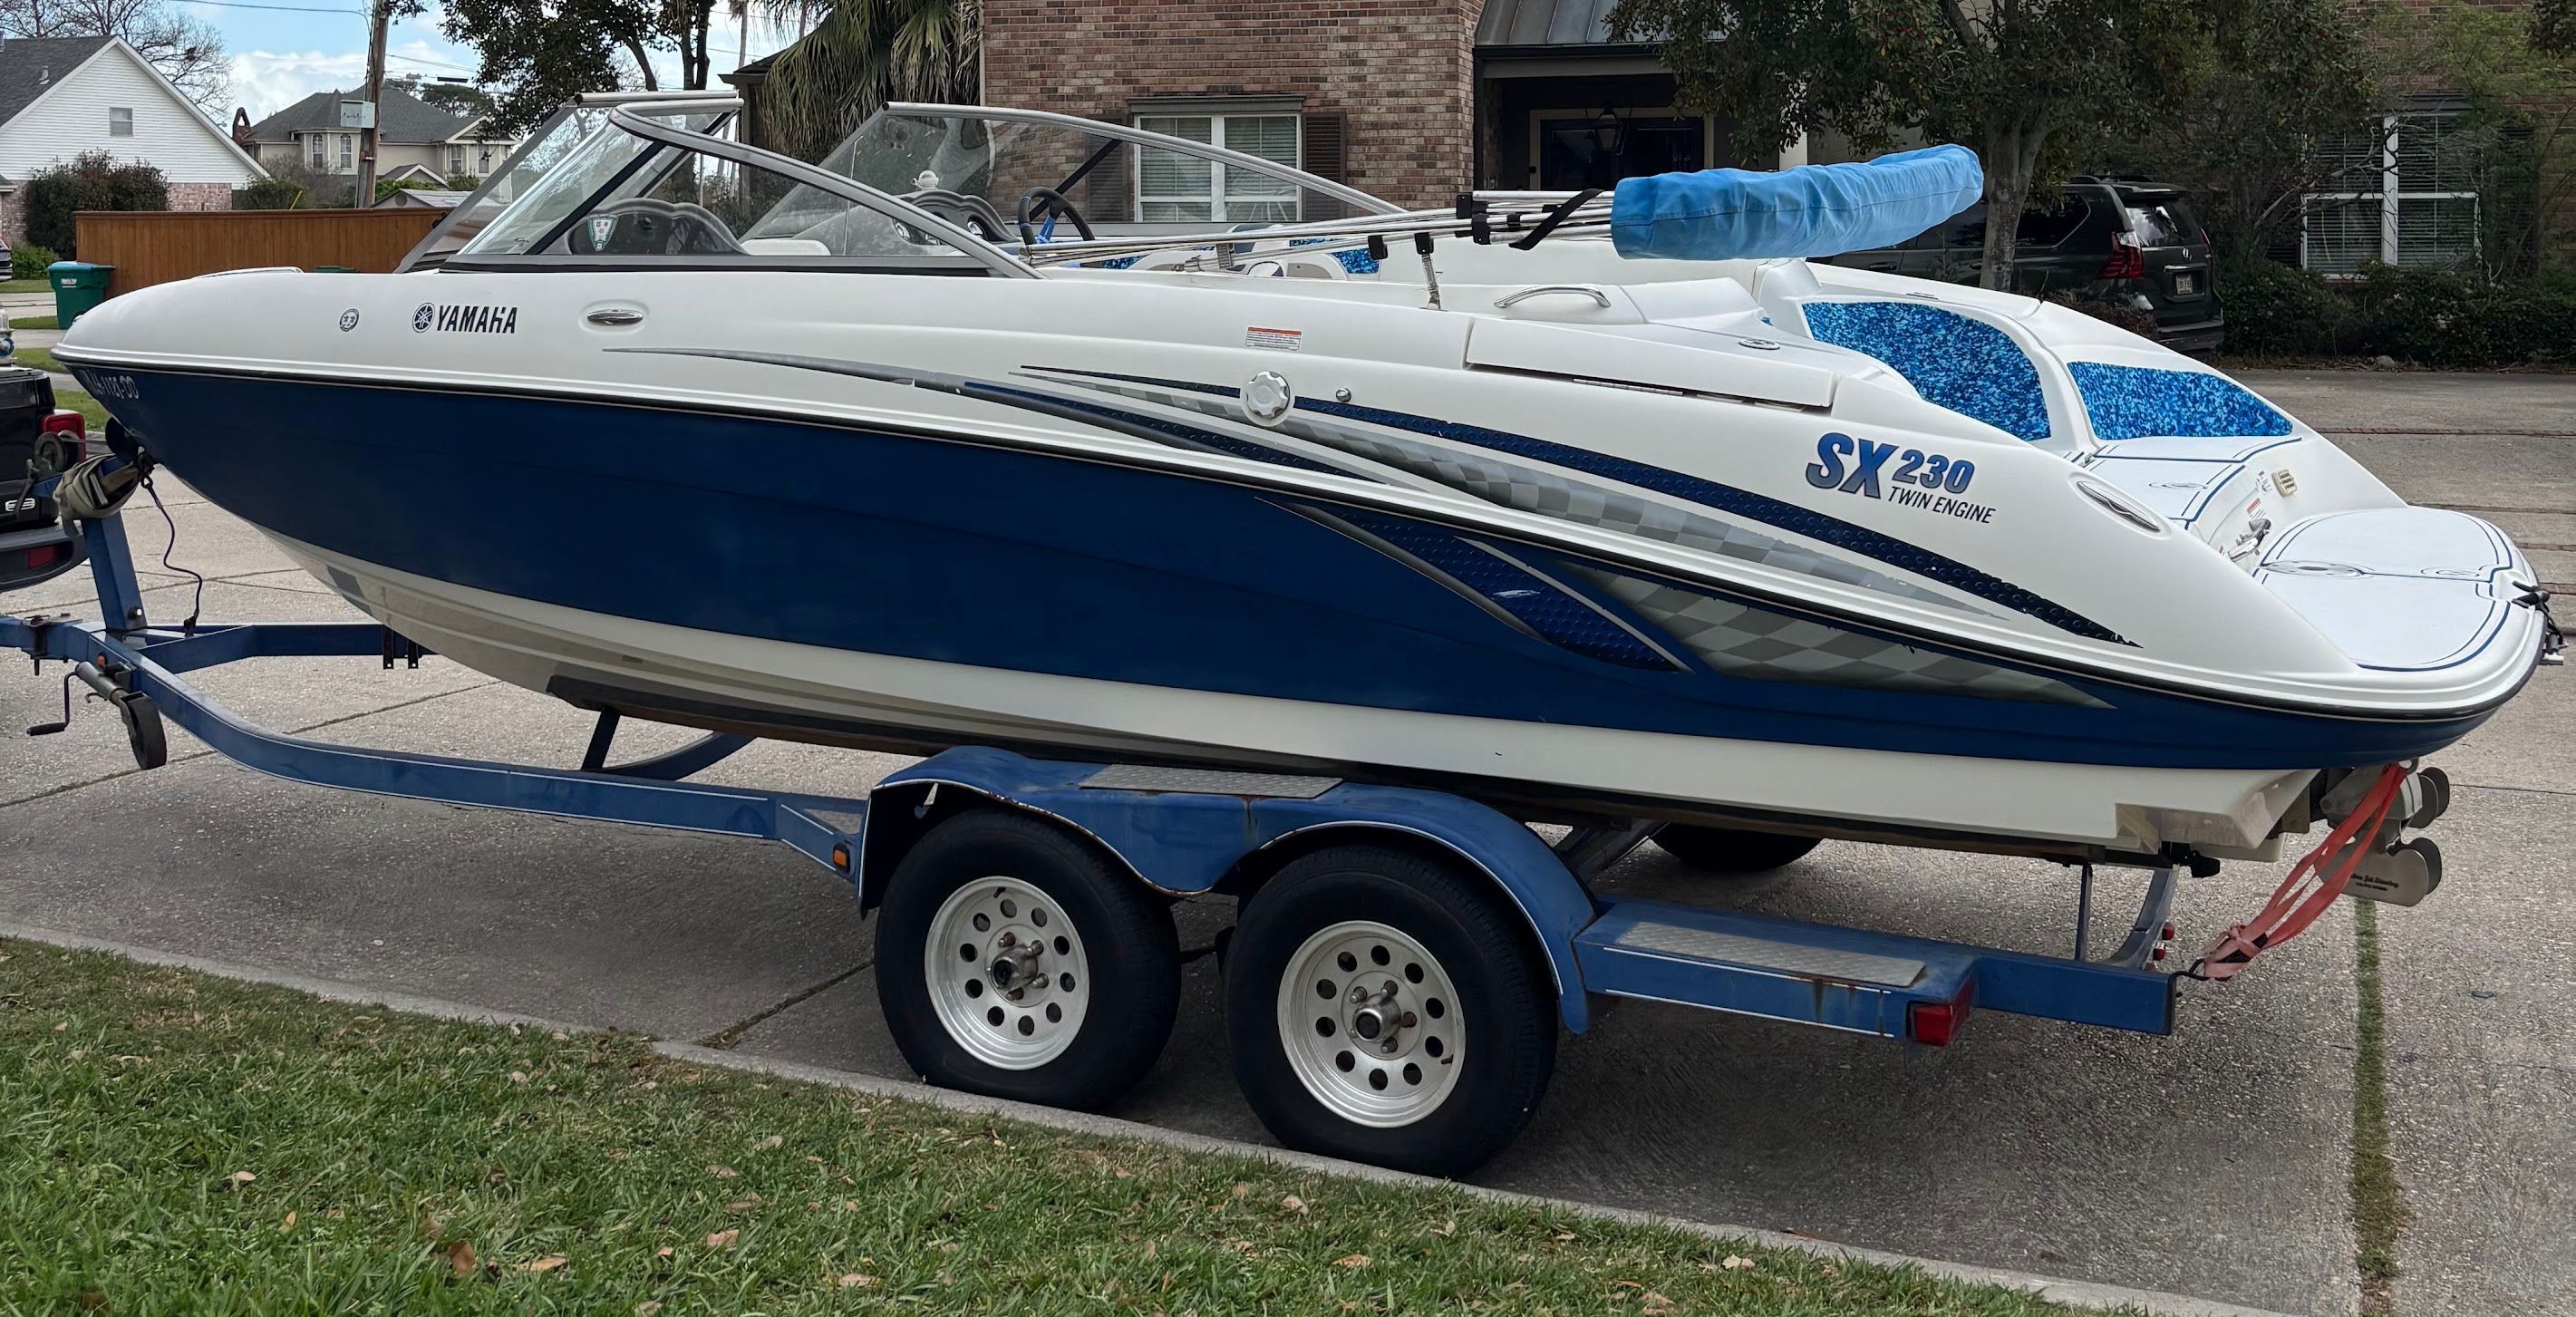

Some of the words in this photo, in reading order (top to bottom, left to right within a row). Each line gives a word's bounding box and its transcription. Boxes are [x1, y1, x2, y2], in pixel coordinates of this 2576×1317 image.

[436, 305, 518, 334] YAMAHA
[1805, 431, 1900, 499] SX
[1892, 449, 1976, 494] 230
[1888, 486, 1933, 509] TWIN
[1932, 496, 1997, 524] ENGINE
